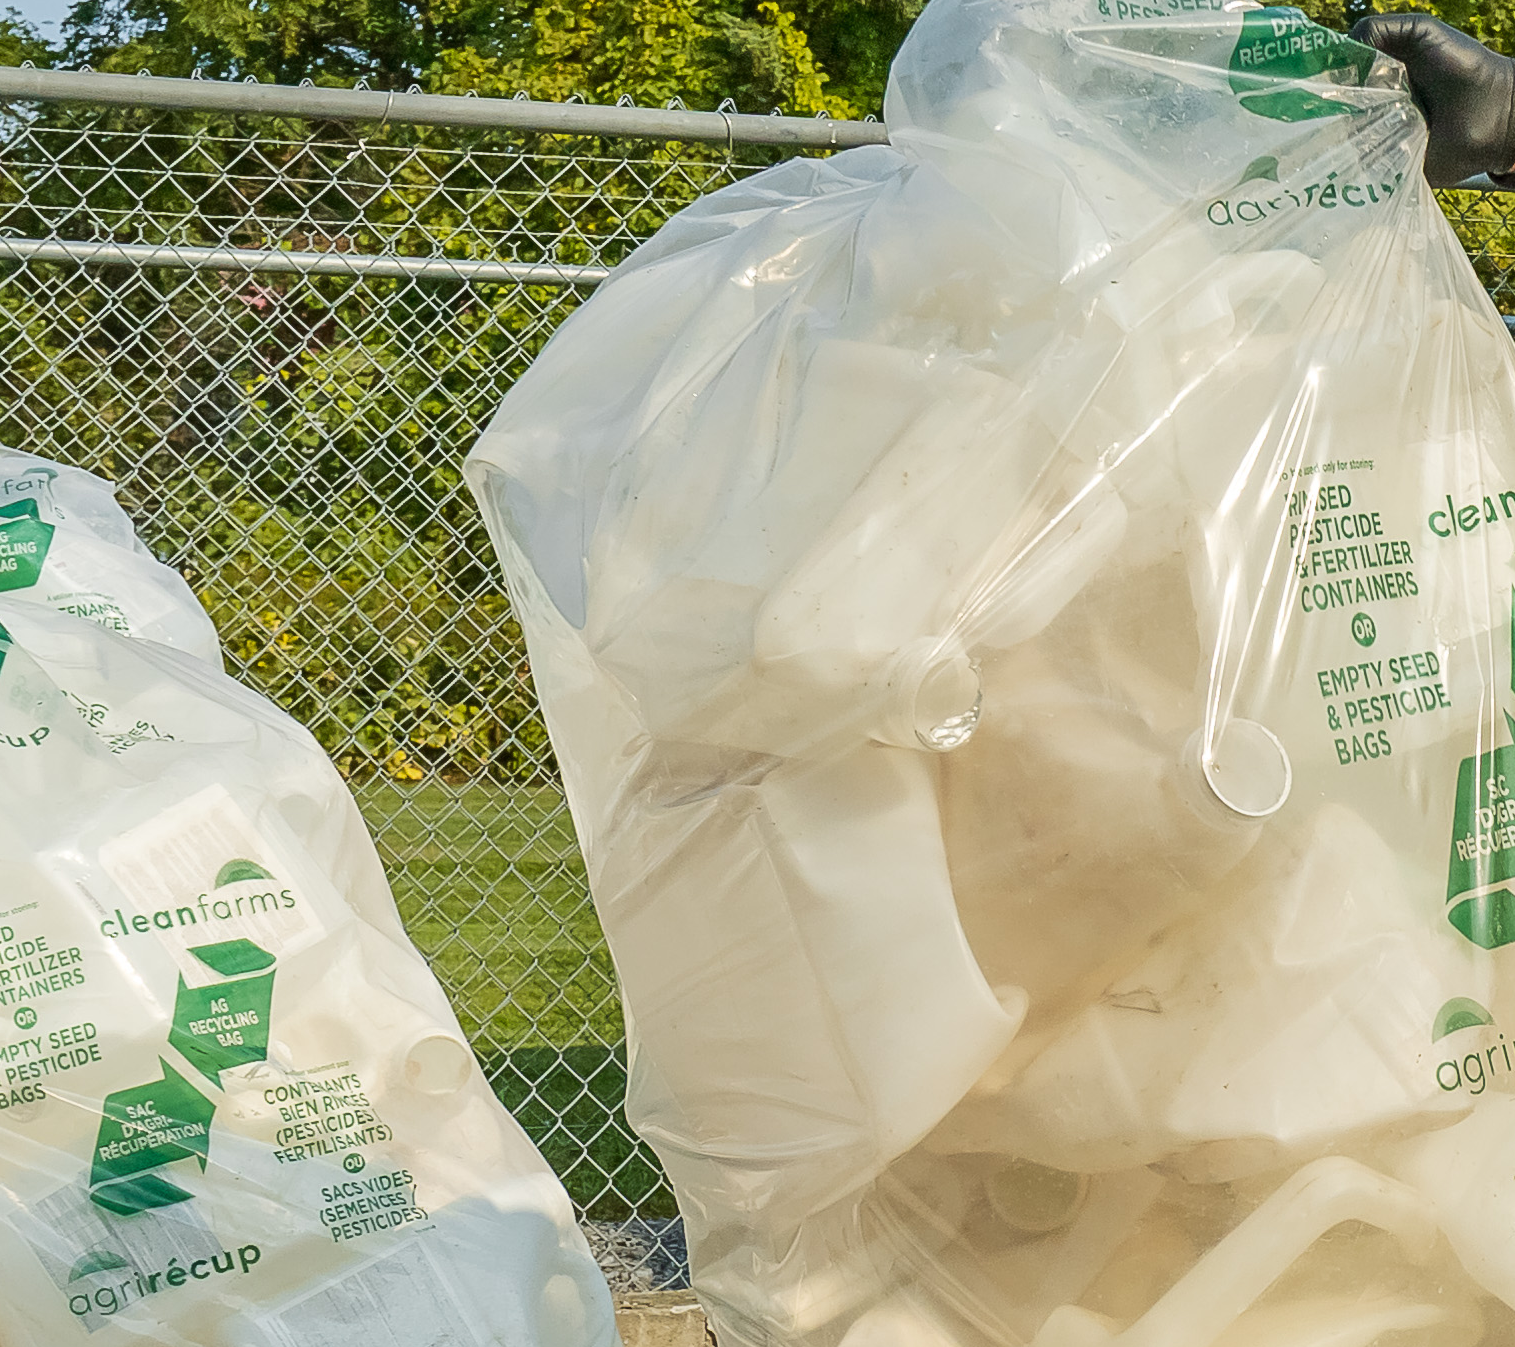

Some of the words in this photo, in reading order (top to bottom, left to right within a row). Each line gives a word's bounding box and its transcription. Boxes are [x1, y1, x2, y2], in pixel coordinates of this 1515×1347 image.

[1284, 484, 1352, 517] RINSED
[1289, 511, 1384, 549] PESTICIDE
[1311, 540, 1414, 577] FERTILIZER
[1301, 570, 1419, 613] CONTAINERS
[1317, 662, 1386, 700] EMPTY
[1390, 650, 1441, 685] SEED
[1326, 705, 1342, 731] &
[1345, 682, 1452, 724] PESTICIDE
[1333, 729, 1393, 766] BAGS
[99, 889, 296, 939] cleanfarms
[188, 1009, 260, 1036] RECYCLING
[210, 997, 230, 1015] AG
[48, 1021, 97, 1050] SEED
[216, 1030, 244, 1047] BAG
[5, 1043, 103, 1085] PESTICIDE
[263, 1073, 362, 1105] CONTENANTS
[121, 1114, 174, 1139] D'AGRI-
[125, 1100, 157, 1120] SAC
[276, 1109, 375, 1147] (PESTICIDES
[278, 1098, 319, 1123] BIEN
[98, 1121, 206, 1162] RÉCUPÉRATION
[272, 1123, 394, 1165] FERTILISANTS)
[321, 1181, 364, 1203] SACS
[361, 1169, 414, 1193] VIDES
[319, 1191, 407, 1227] (SEMENCES
[330, 1206, 430, 1243] PESTICIDES)
[68, 1243, 262, 1316] agrirécup
